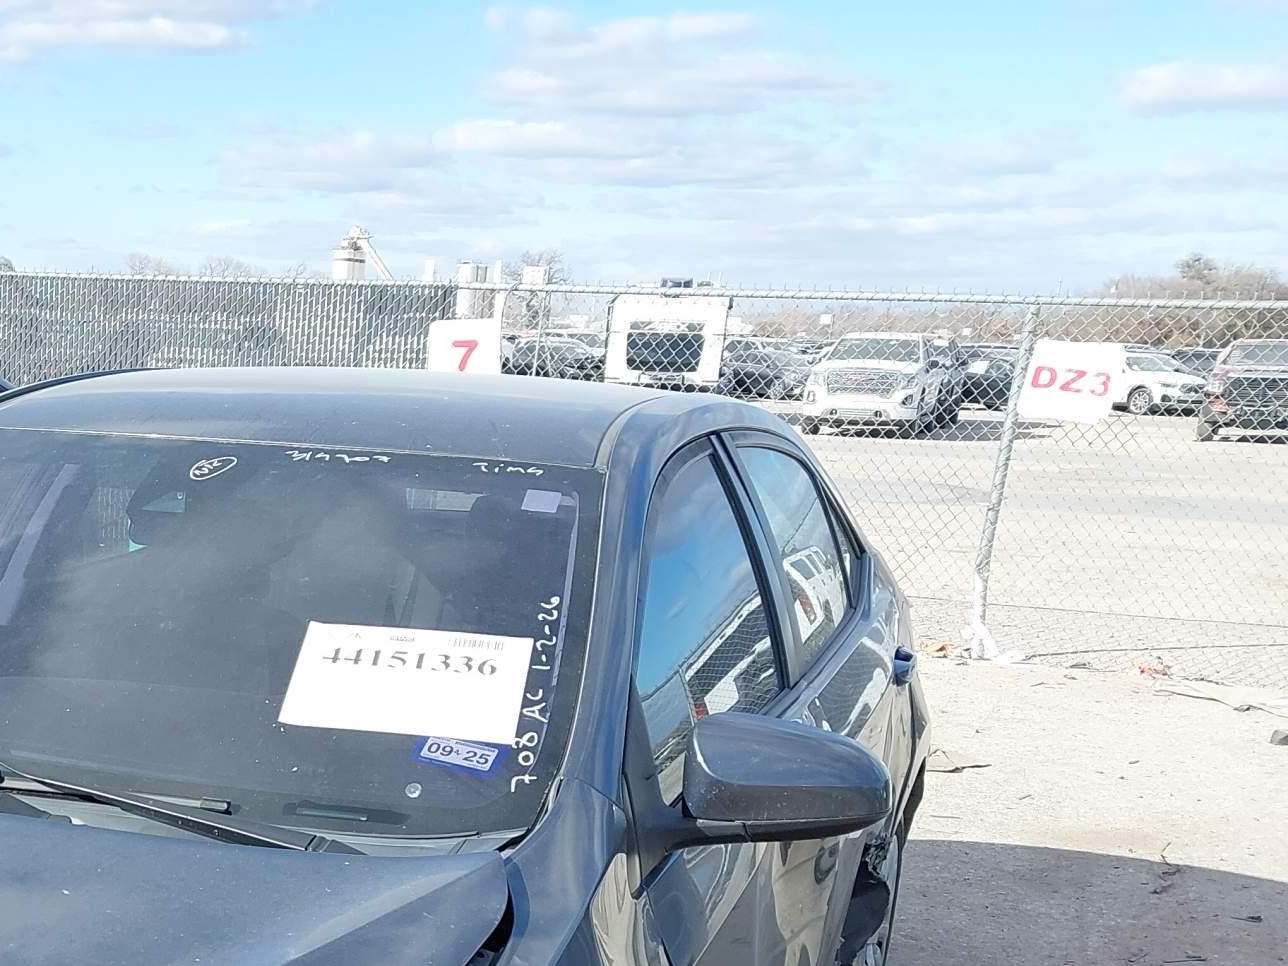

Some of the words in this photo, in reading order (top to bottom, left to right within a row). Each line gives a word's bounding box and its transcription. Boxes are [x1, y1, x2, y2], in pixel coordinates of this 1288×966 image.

[452, 339, 479, 371] 7
[1031, 365, 1111, 397] DZ3
[322, 647, 497, 677] 44151336
[522, 688, 550, 723] AC
[427, 742, 454, 758] 09
[462, 750, 492, 766] 25
